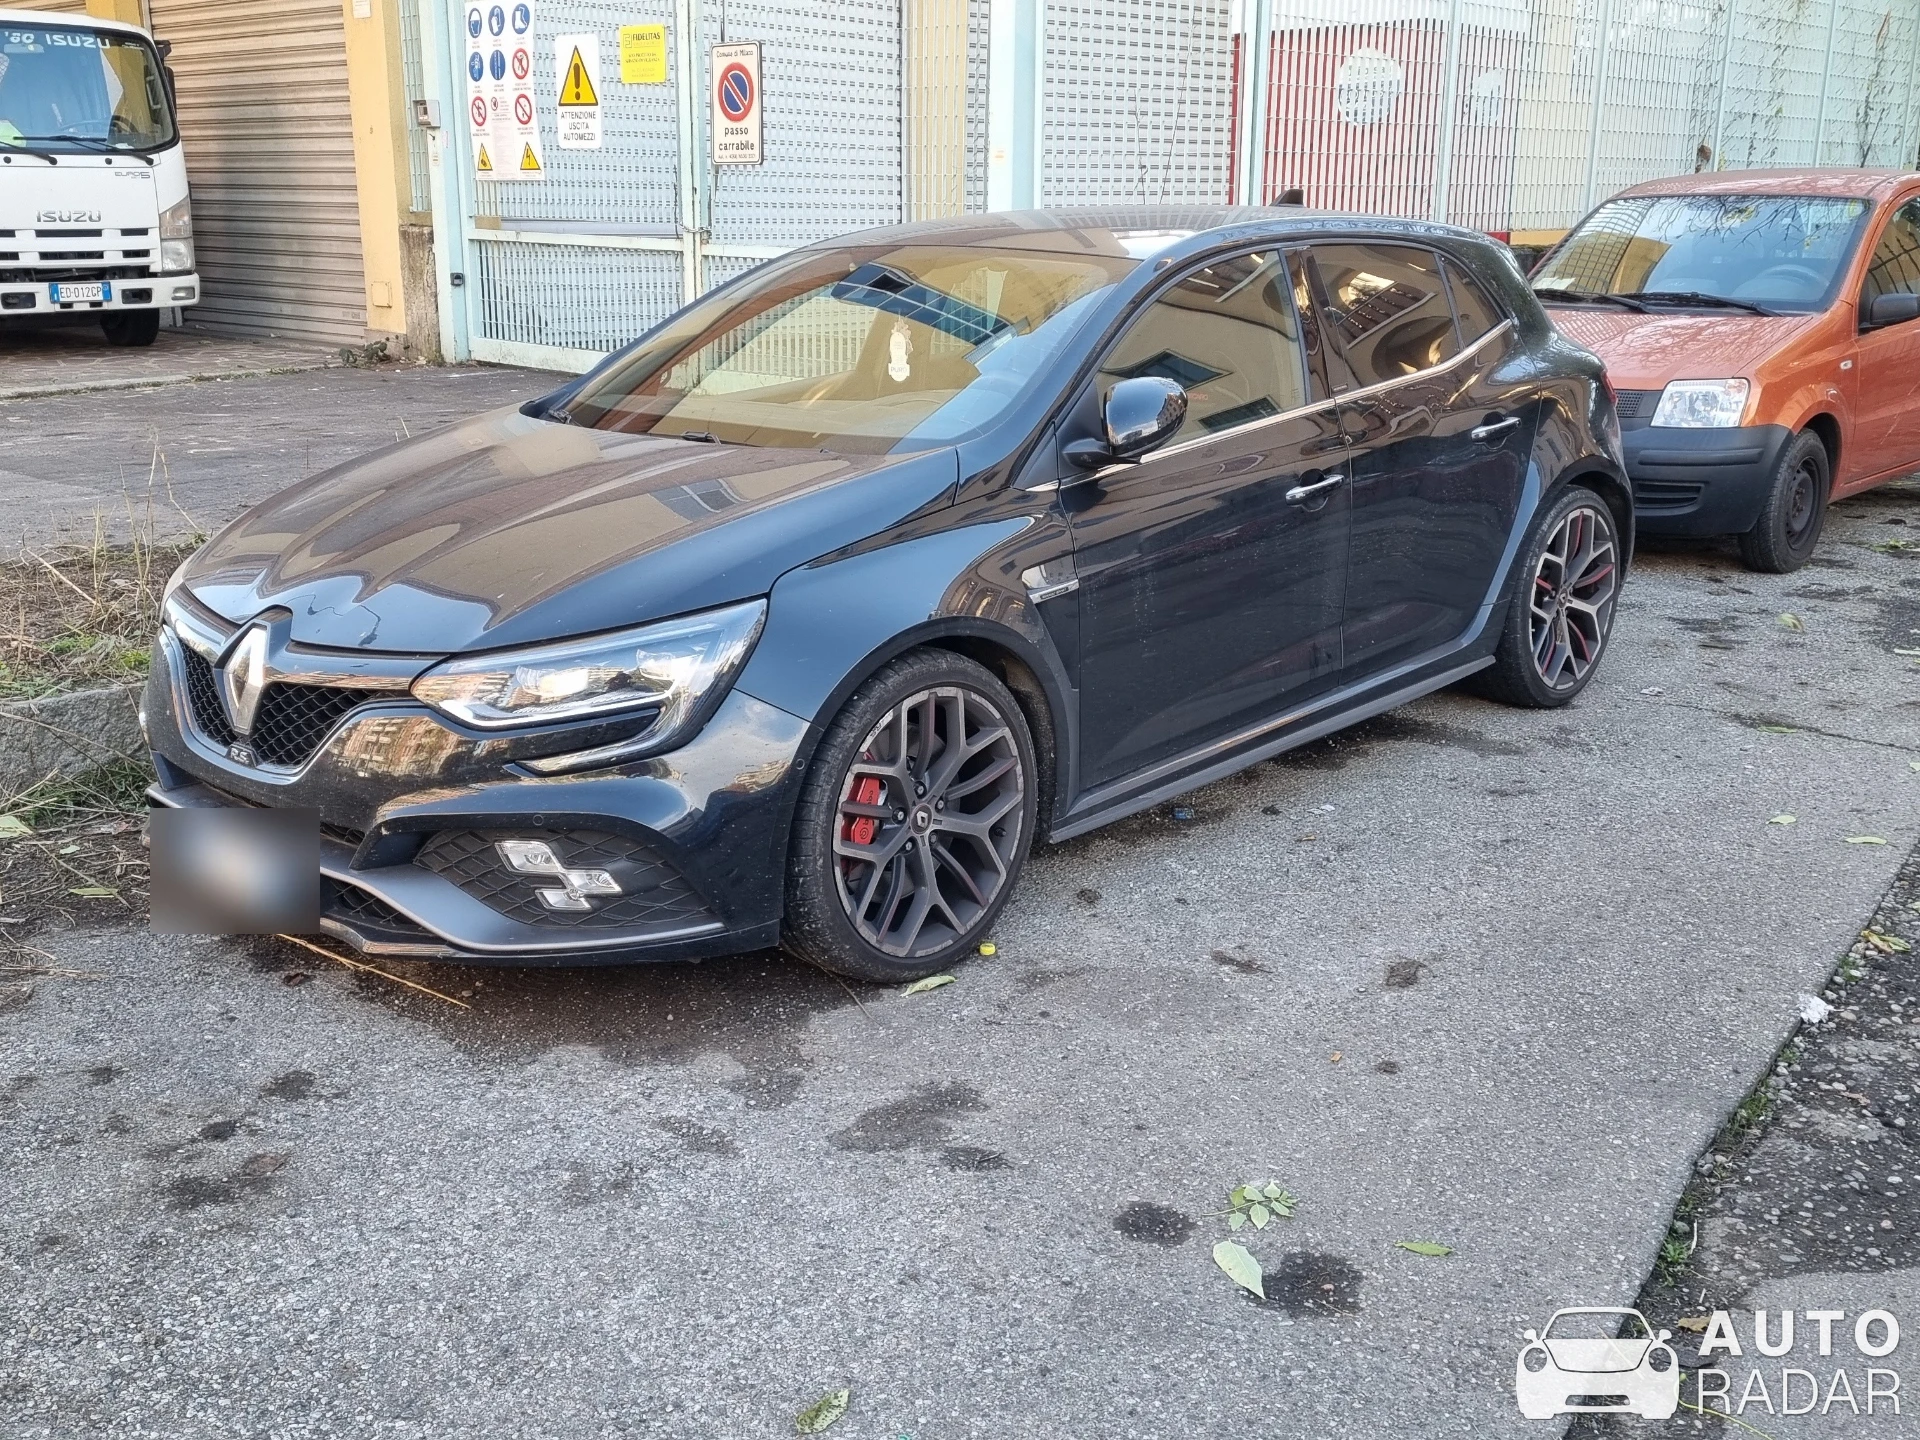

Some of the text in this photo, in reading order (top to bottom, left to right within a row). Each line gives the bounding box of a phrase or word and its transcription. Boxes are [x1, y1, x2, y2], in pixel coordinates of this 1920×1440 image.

[45, 33, 111, 49] ISUZU
[632, 32, 661, 41] FIDELITAS
[560, 111, 597, 119] ATTENZIONE
[568, 122, 590, 130] USCITA
[563, 132, 596, 141] AUTOMEZZI
[724, 127, 749, 137] passo
[718, 140, 755, 151] carrabile
[36, 210, 102, 223] ISUZU
